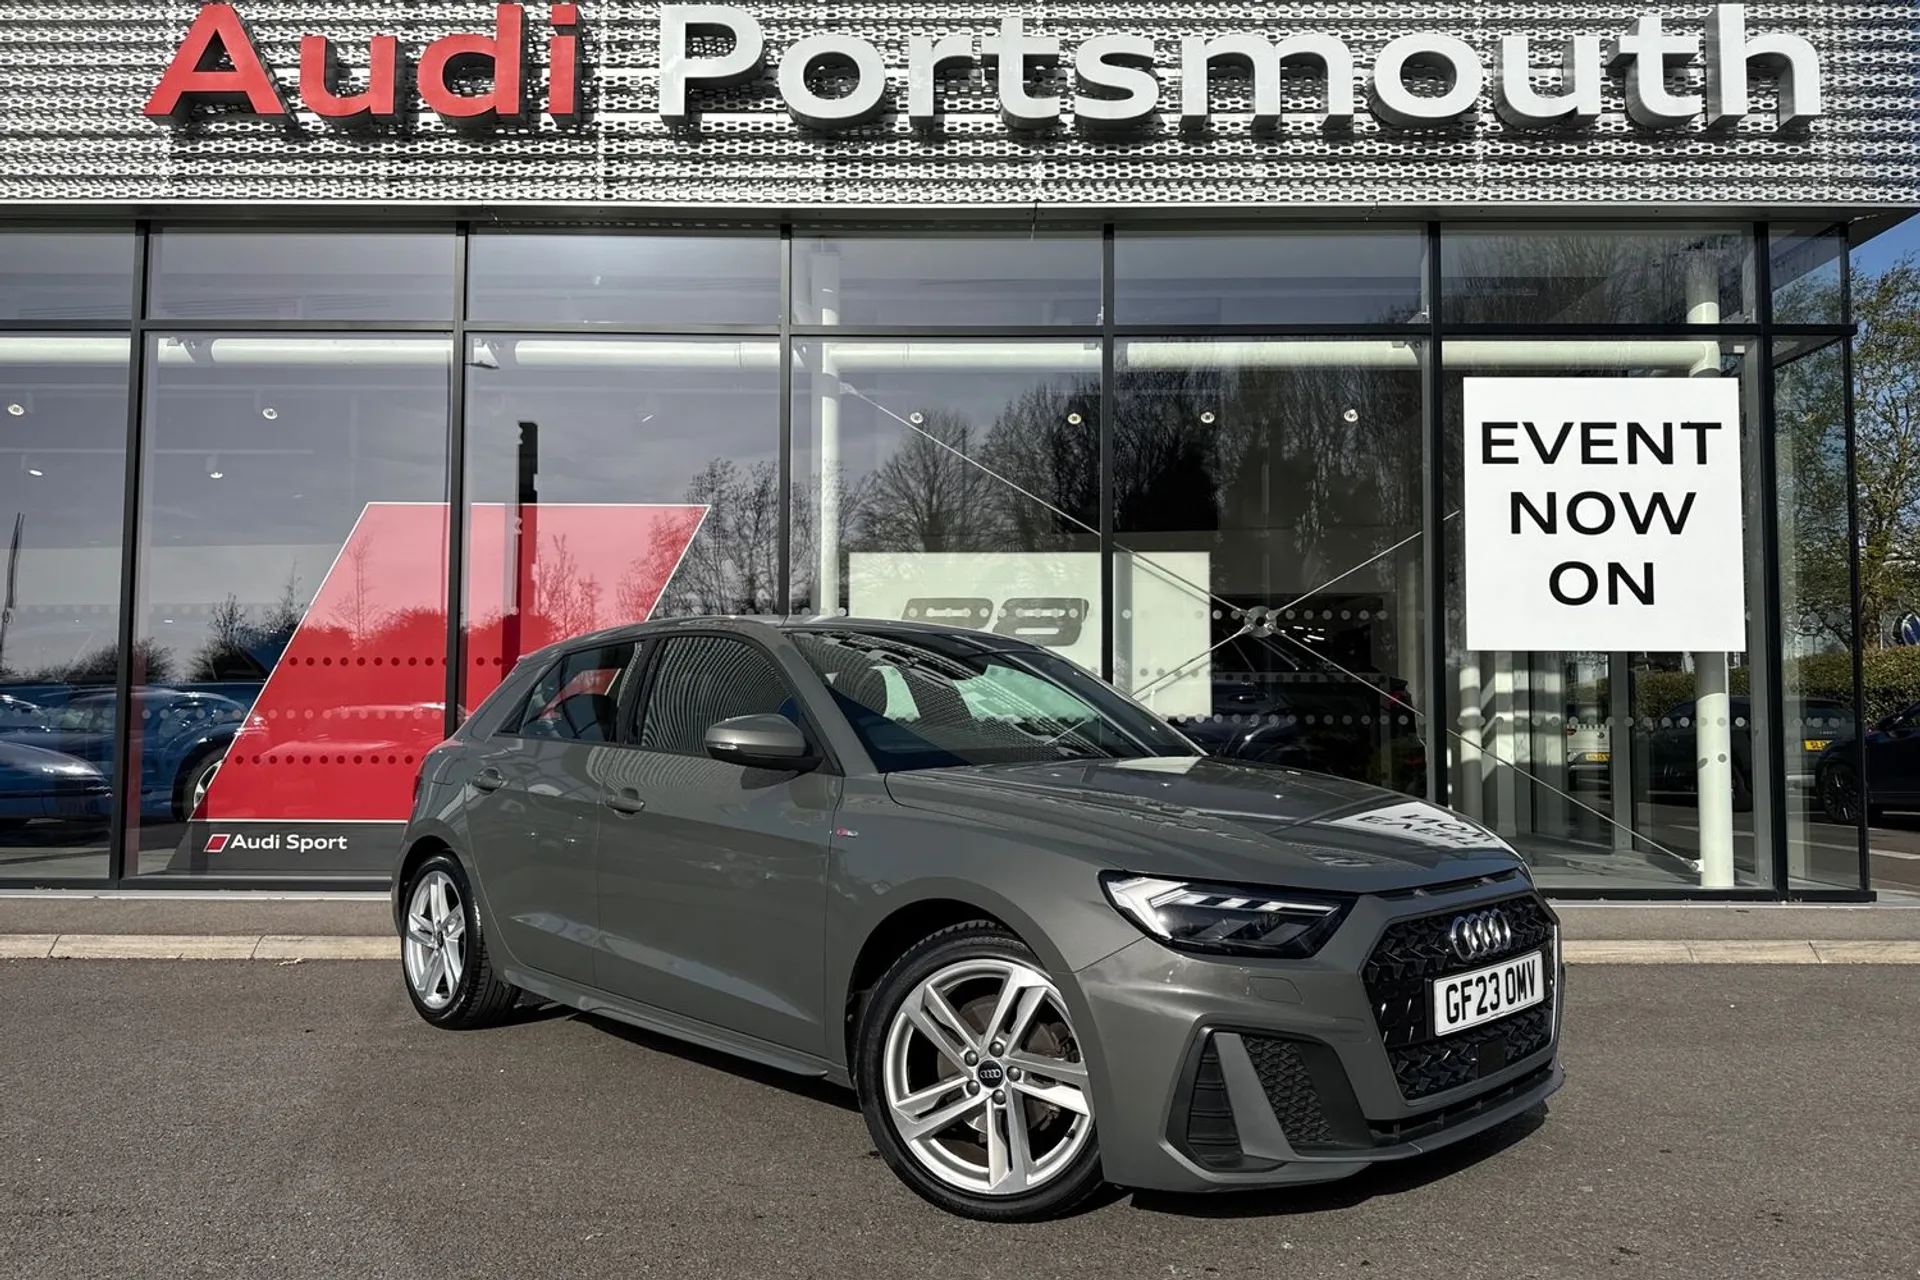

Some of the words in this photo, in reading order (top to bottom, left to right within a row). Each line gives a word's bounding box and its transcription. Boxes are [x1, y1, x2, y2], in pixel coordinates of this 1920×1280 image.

[144, 3, 577, 118] Audi
[659, 3, 1821, 120] Portsmouth
[1481, 421, 1722, 465] EVENT
[1510, 491, 1697, 535] NOW
[1549, 561, 1655, 606] ON
[230, 834, 280, 849] Audi
[286, 834, 348, 853] Sport
[1446, 972, 1500, 1024] GF23
[1505, 960, 1535, 1005] OMV
